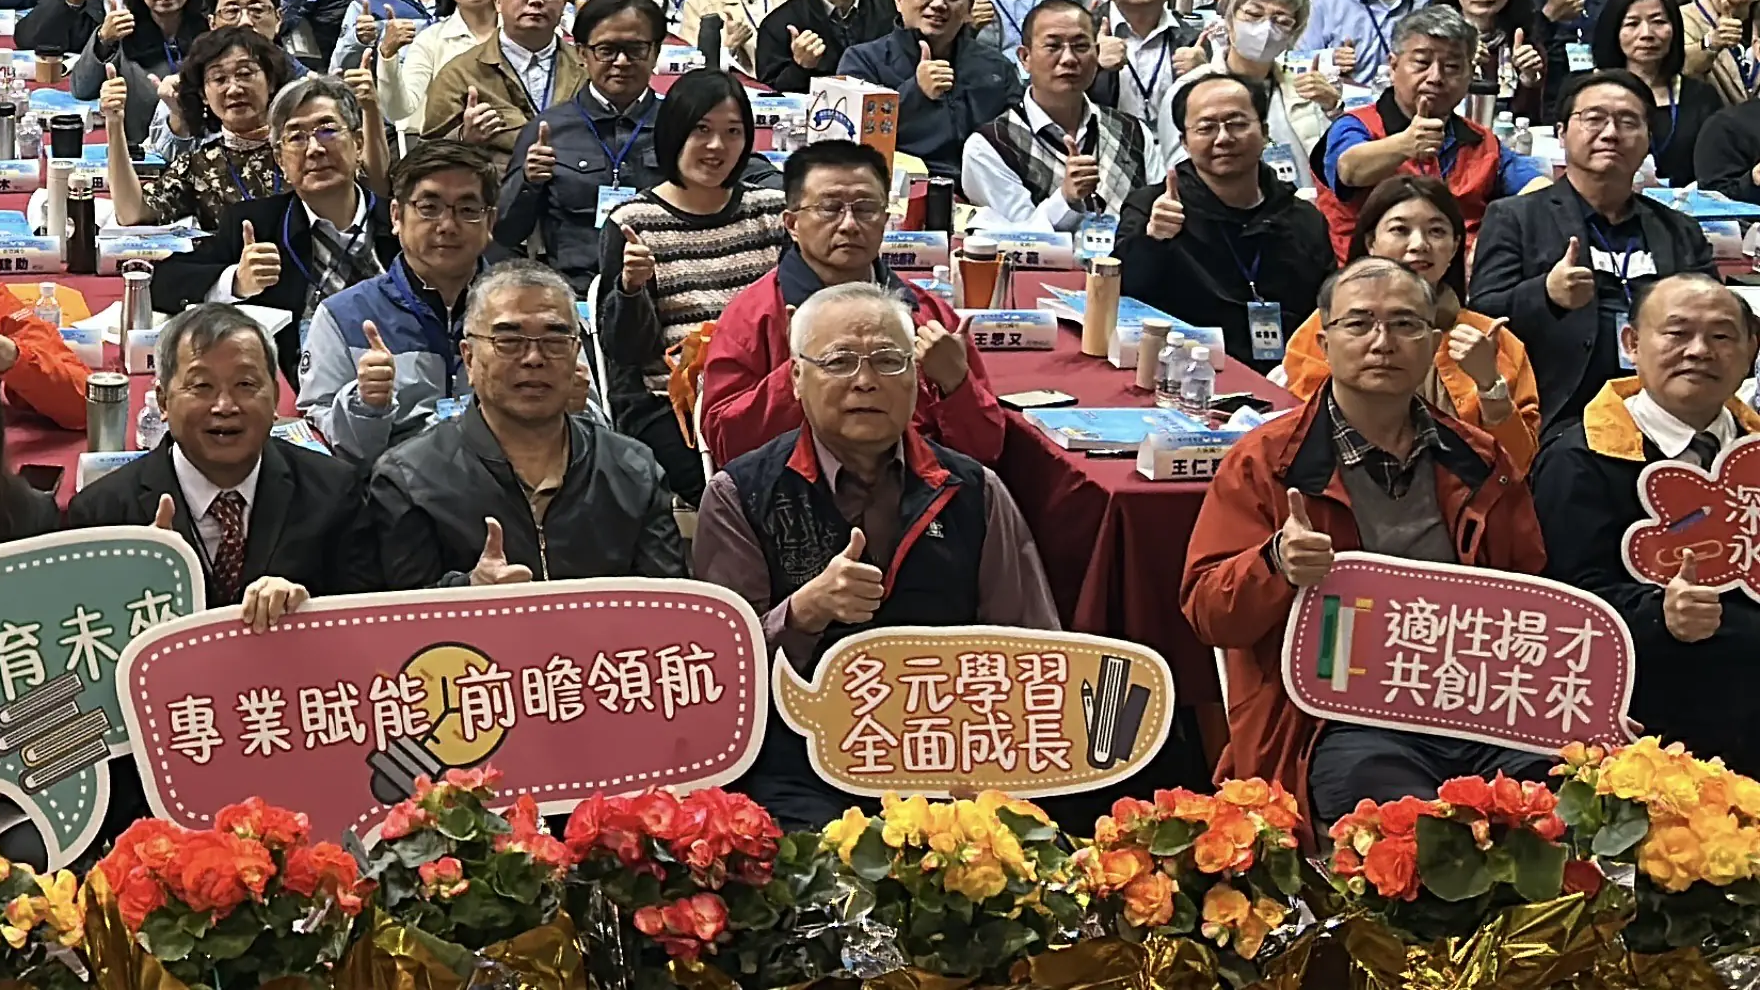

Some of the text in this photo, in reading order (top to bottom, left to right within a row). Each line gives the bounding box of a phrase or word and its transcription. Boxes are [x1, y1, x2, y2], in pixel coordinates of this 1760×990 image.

[1383, 595, 1605, 671] 適性揚才
[166, 642, 727, 765] 專業賦能 前瞻領航
[842, 652, 1070, 716] 多元學習
[1379, 650, 1594, 734] 共創未來
[840, 712, 1074, 774] 全面成長
